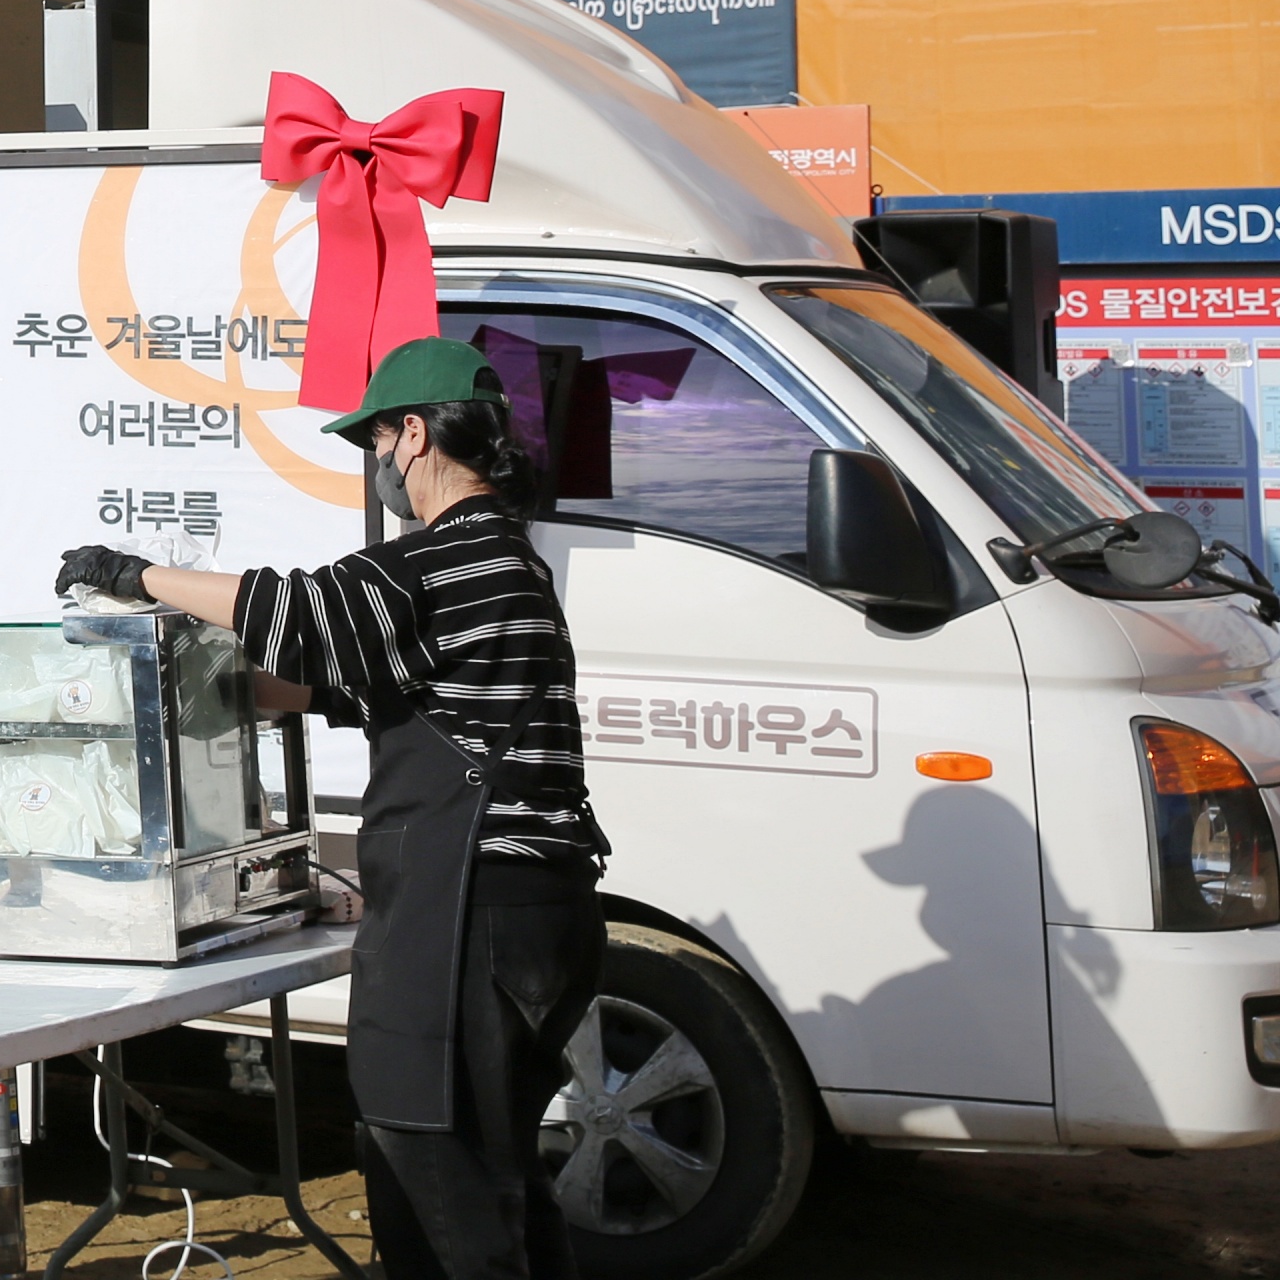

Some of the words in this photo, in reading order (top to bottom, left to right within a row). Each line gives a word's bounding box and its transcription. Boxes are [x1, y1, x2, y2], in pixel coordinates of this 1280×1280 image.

[1161, 204, 1280, 247] MSD
[12, 312, 93, 359] 추운
[104, 313, 308, 361] 겨울날에도
[79, 401, 242, 449] 여러분의
[96, 487, 223, 537] 하루를
[576, 694, 865, 758] 트럭하우스
